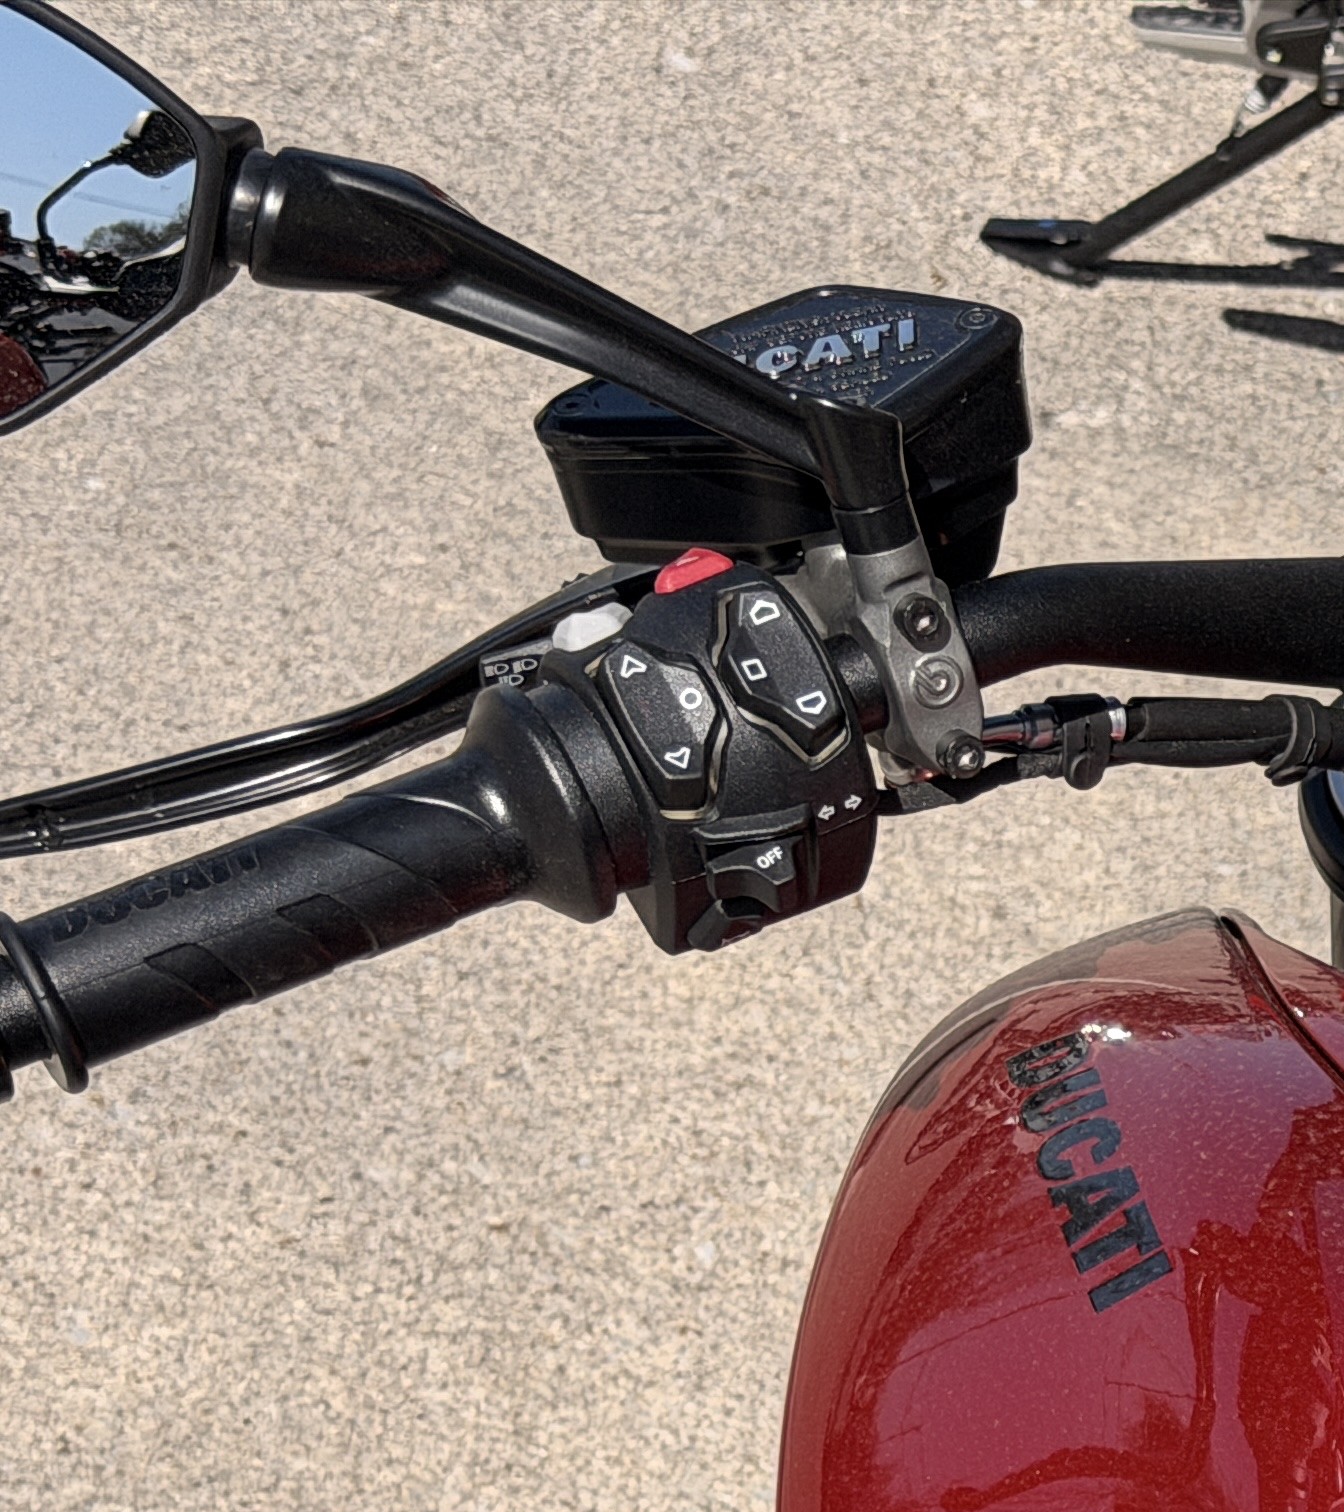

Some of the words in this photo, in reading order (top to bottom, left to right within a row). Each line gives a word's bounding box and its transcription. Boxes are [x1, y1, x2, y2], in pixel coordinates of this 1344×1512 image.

[736, 317, 916, 379] CATI
[756, 846, 783, 869] OFF
[1005, 1032, 1173, 1314] DUCATI
